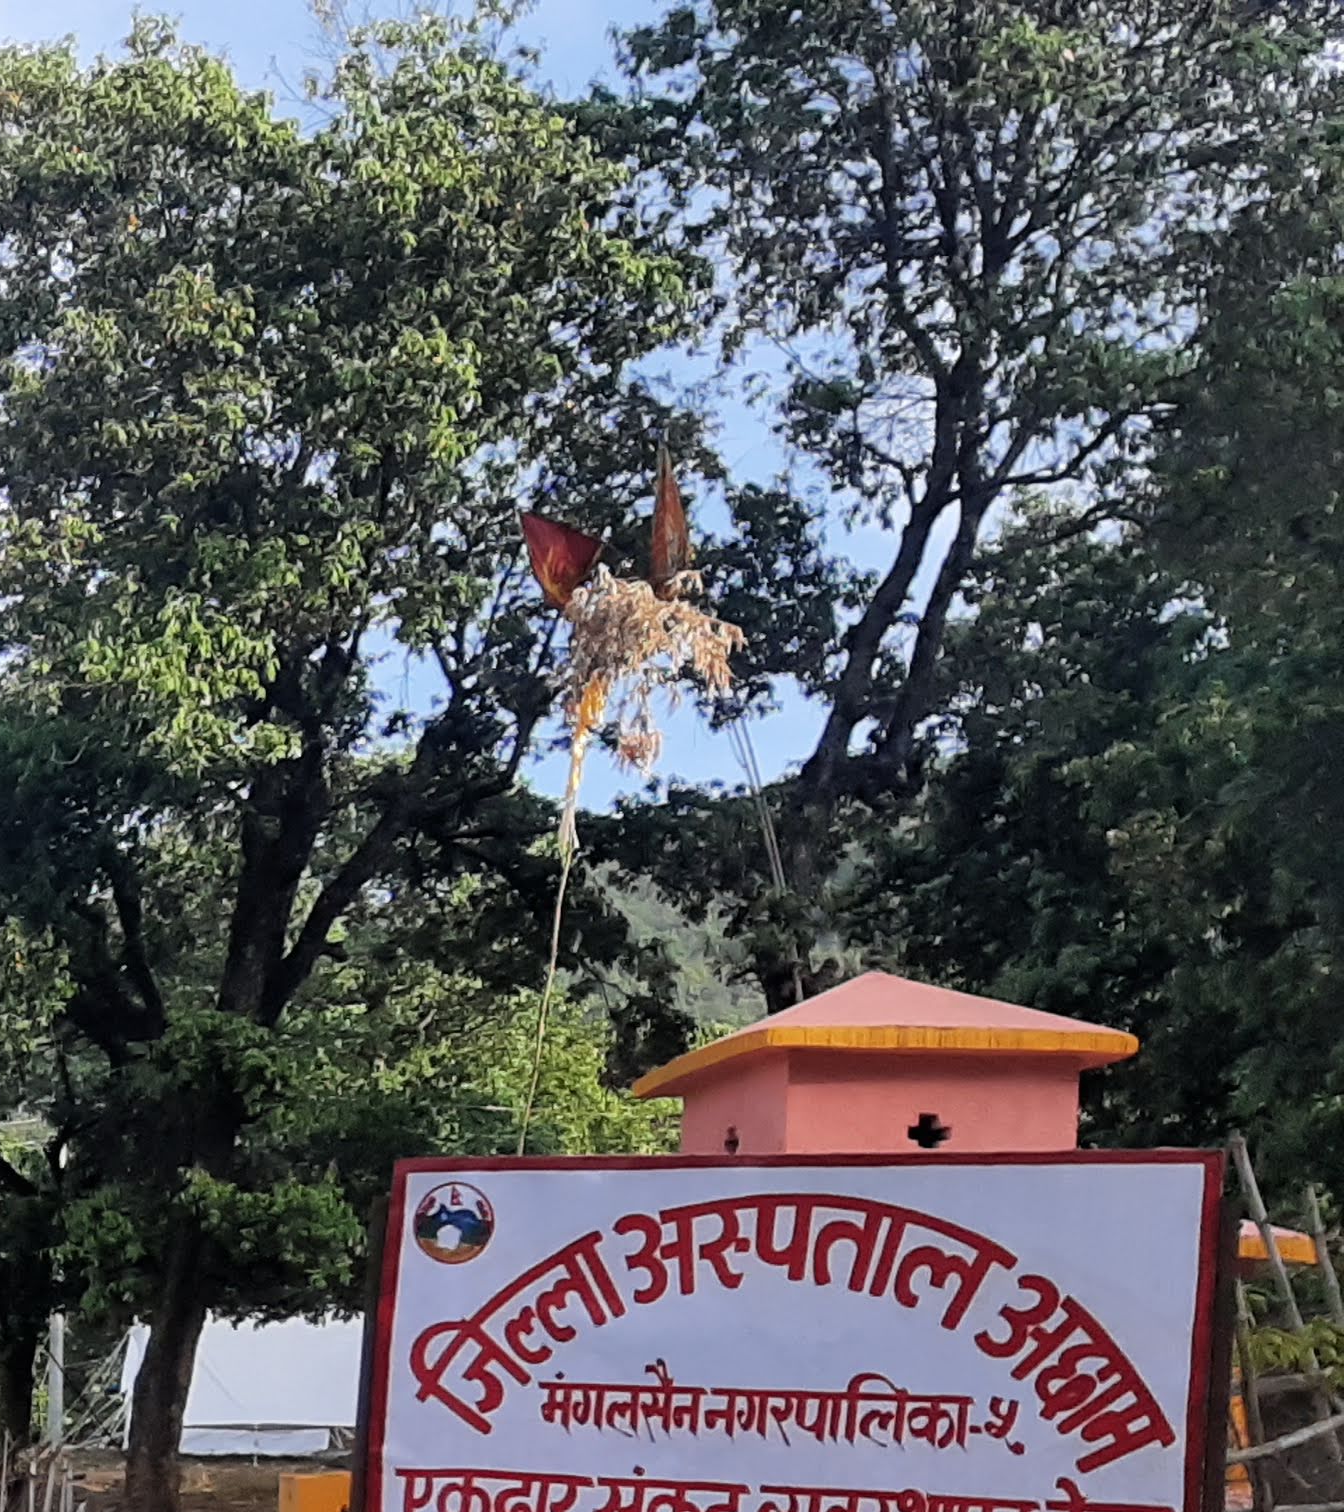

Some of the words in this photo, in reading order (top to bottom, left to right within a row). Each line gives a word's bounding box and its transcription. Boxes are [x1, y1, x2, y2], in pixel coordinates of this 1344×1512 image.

[410, 1230, 626, 1435] जिल्ला
[613, 1193, 1018, 1331] अस्पताल
[974, 1274, 1177, 1474] अछाम
[538, 1358, 708, 1443] मंगलसैन
